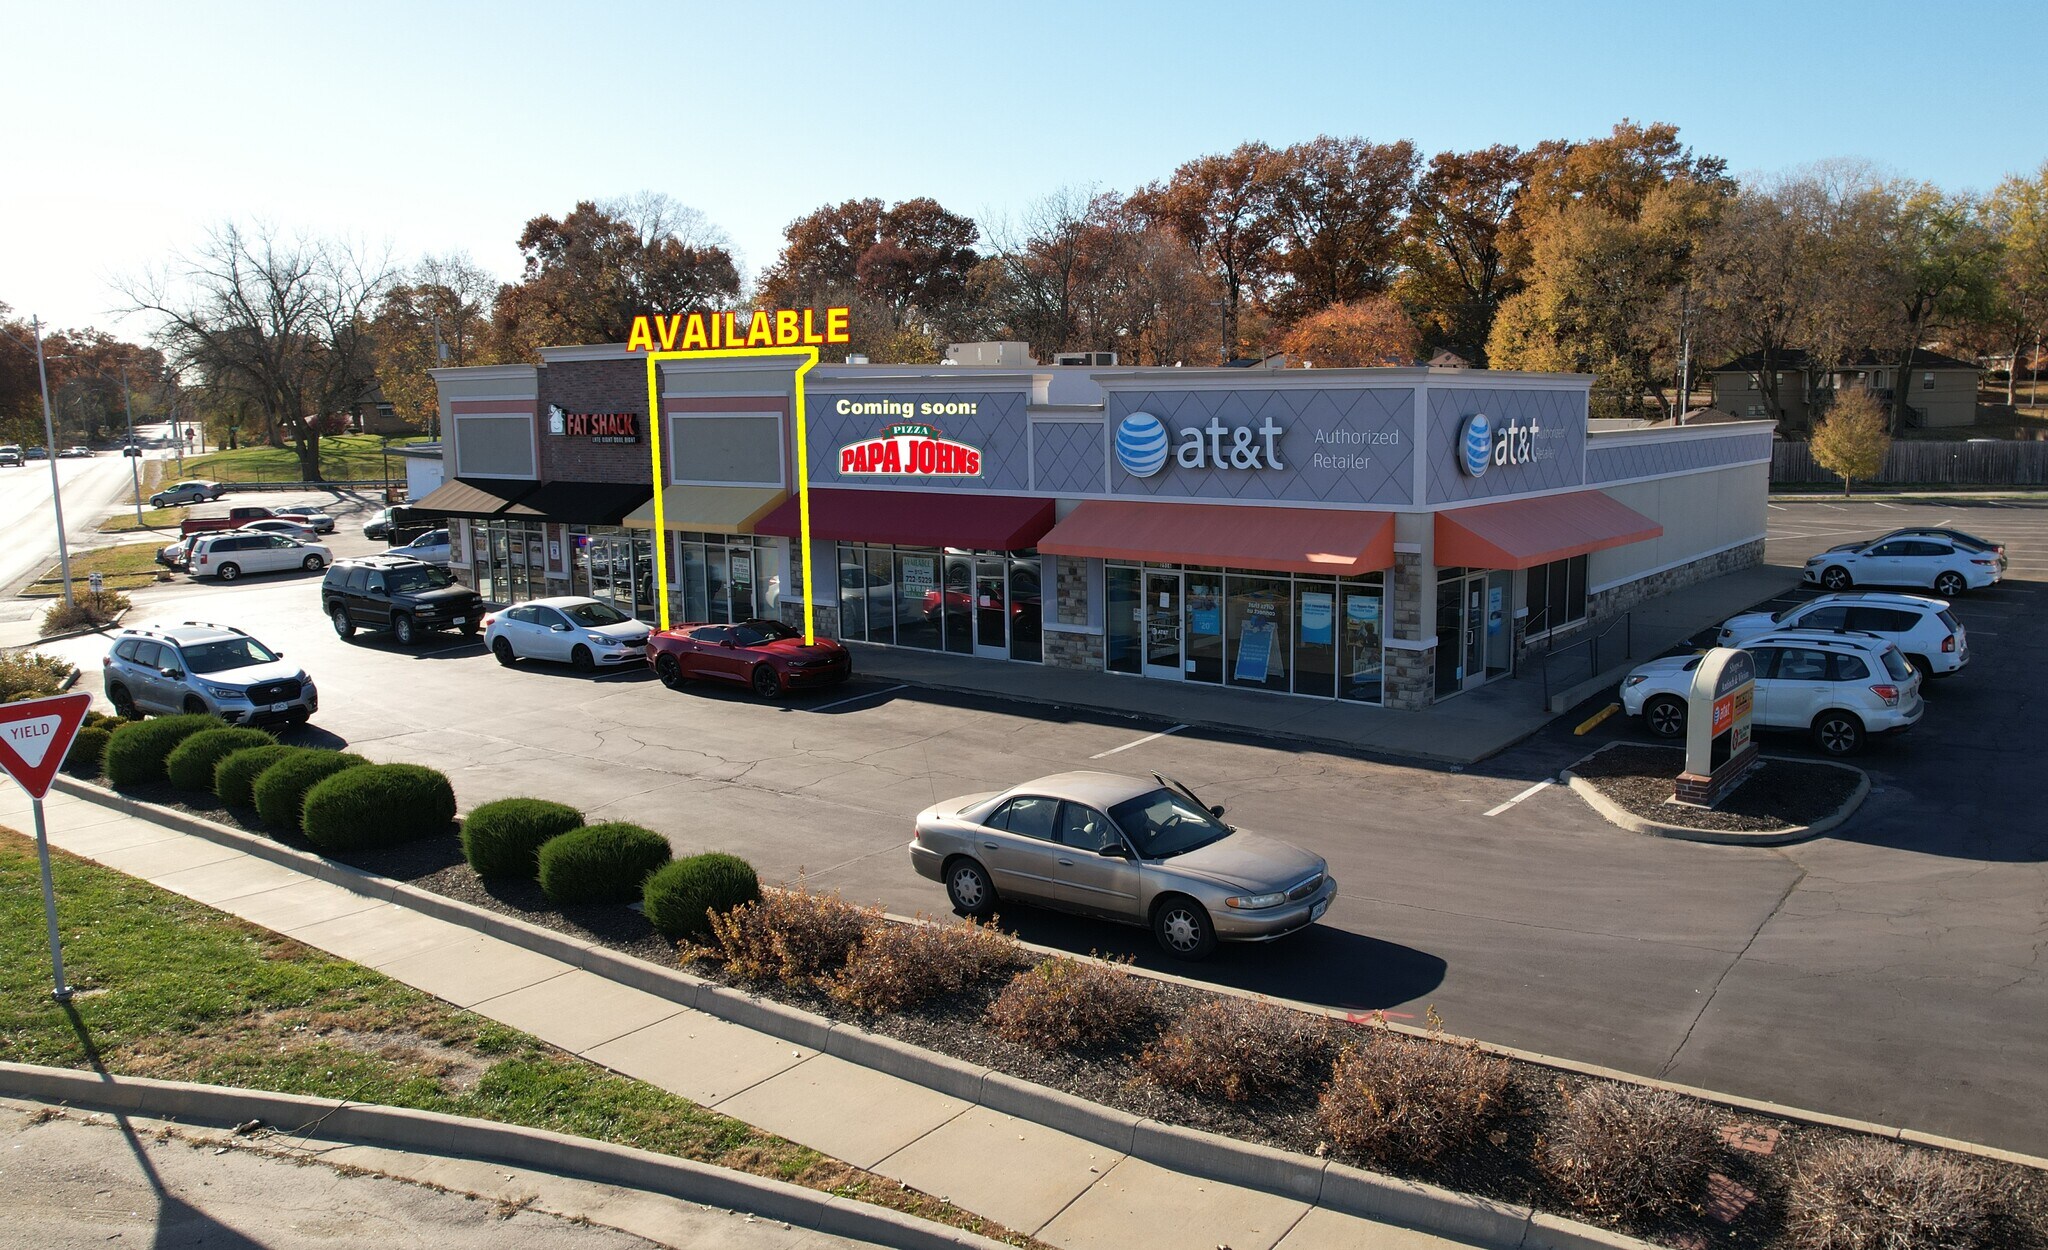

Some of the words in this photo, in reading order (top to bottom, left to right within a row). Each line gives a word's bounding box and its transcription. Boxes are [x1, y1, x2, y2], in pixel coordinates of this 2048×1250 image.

[567, 413, 588, 435] FAT
[591, 413, 634, 435] SHACK
[1177, 417, 1283, 470] at&t
[1314, 429, 1399, 445] Authorized
[1495, 418, 1539, 466] at&t
[1313, 452, 1371, 469] Retailer
[11, 723, 50, 740] YIELD
